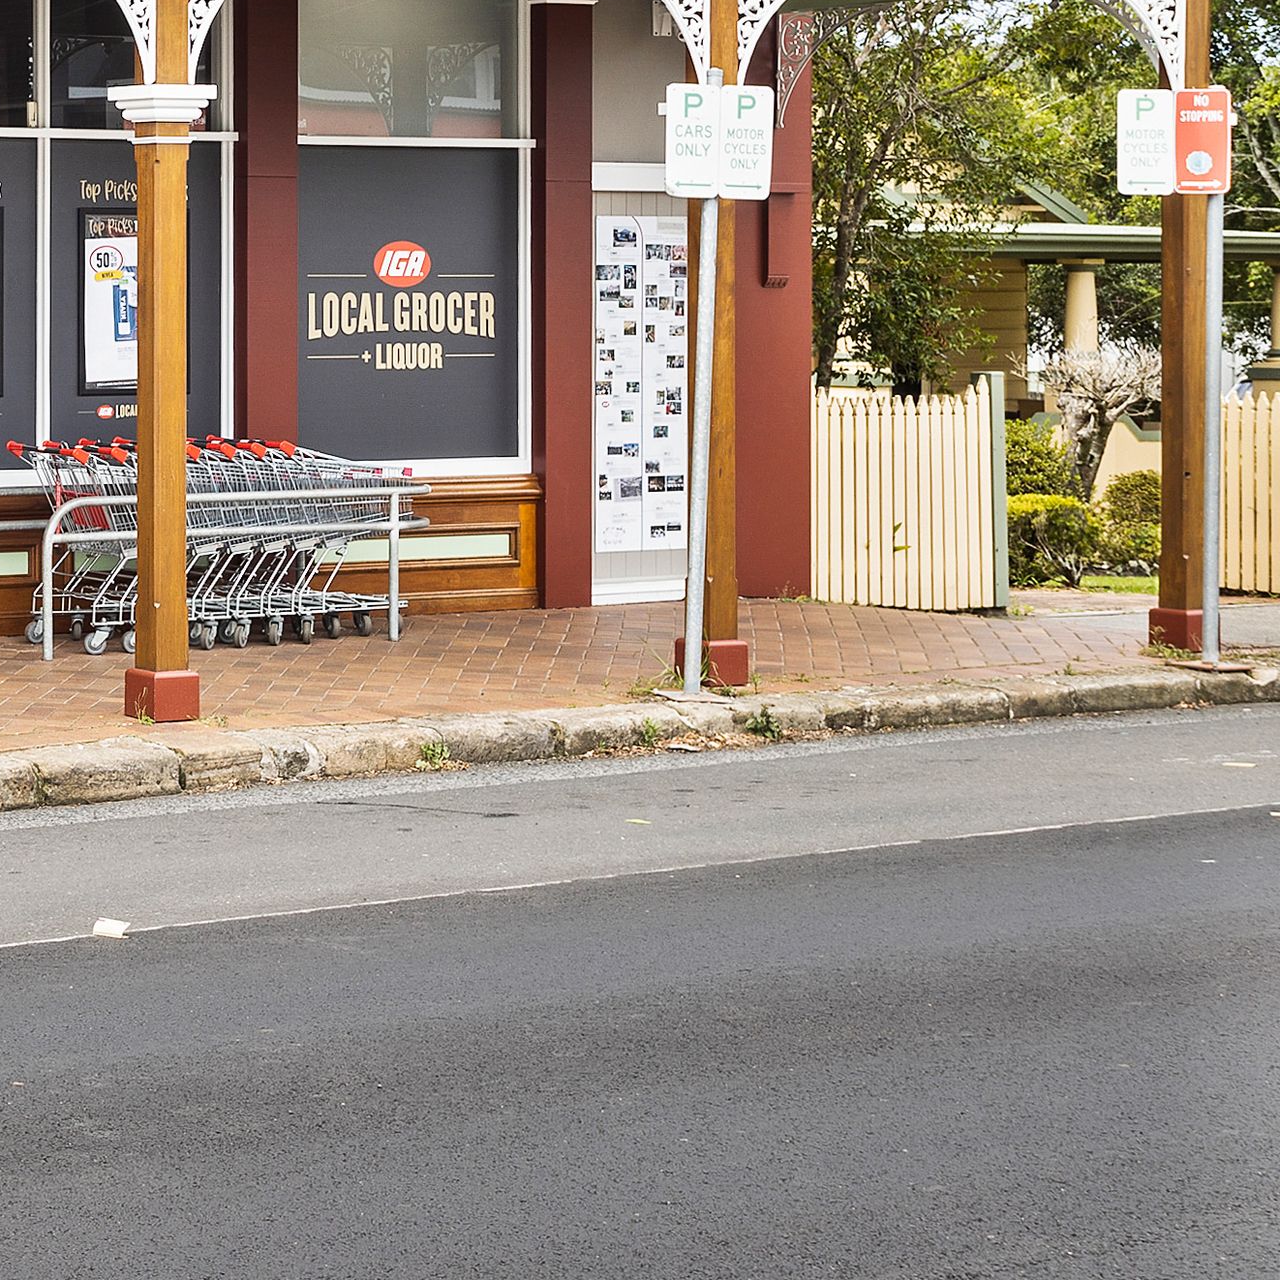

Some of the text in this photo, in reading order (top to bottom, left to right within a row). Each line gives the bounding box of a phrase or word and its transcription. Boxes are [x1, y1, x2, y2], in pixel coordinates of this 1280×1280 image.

[684, 93, 703, 118] P
[737, 95, 756, 119] P
[1193, 95, 1210, 107] NO
[1135, 98, 1155, 120] P
[1180, 110, 1224, 122] STOPPING
[675, 124, 713, 138] CARS
[726, 128, 765, 140] MOTOR
[1126, 129, 1165, 140] MOTOR
[675, 143, 711, 157] ONLY
[724, 143, 767, 155] CYCLES
[1123, 143, 1168, 154] CYCLES
[730, 158, 759, 169] ONLY
[1130, 156, 1160, 168] ONLY
[80, 179, 137, 203] Top Picks
[88, 218, 133, 236] Top Picks
[96, 252, 109, 267] 50
[379, 250, 424, 277] IGA
[120, 295, 128, 321] NIVEA
[308, 291, 495, 340] LOCAL GROCER
[375, 342, 443, 370] LIQUOR
